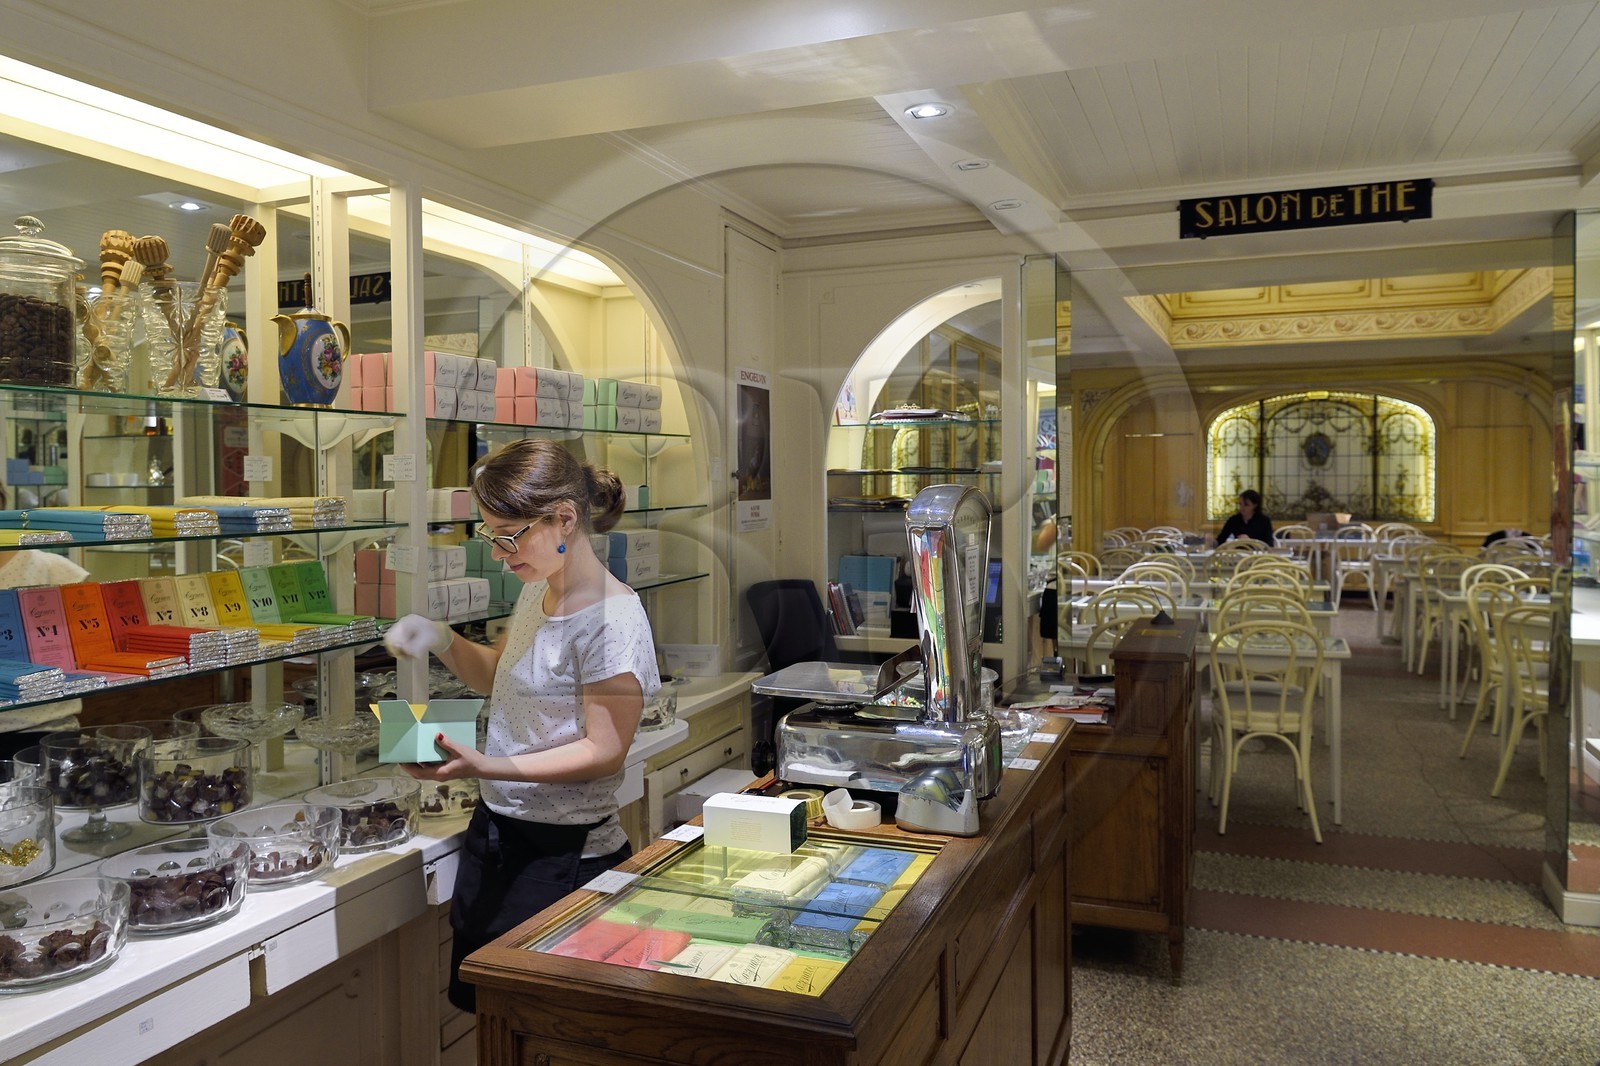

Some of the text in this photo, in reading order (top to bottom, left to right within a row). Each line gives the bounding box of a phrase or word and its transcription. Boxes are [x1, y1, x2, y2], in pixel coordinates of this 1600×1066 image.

[1194, 181, 1417, 229] SALON DE THE
